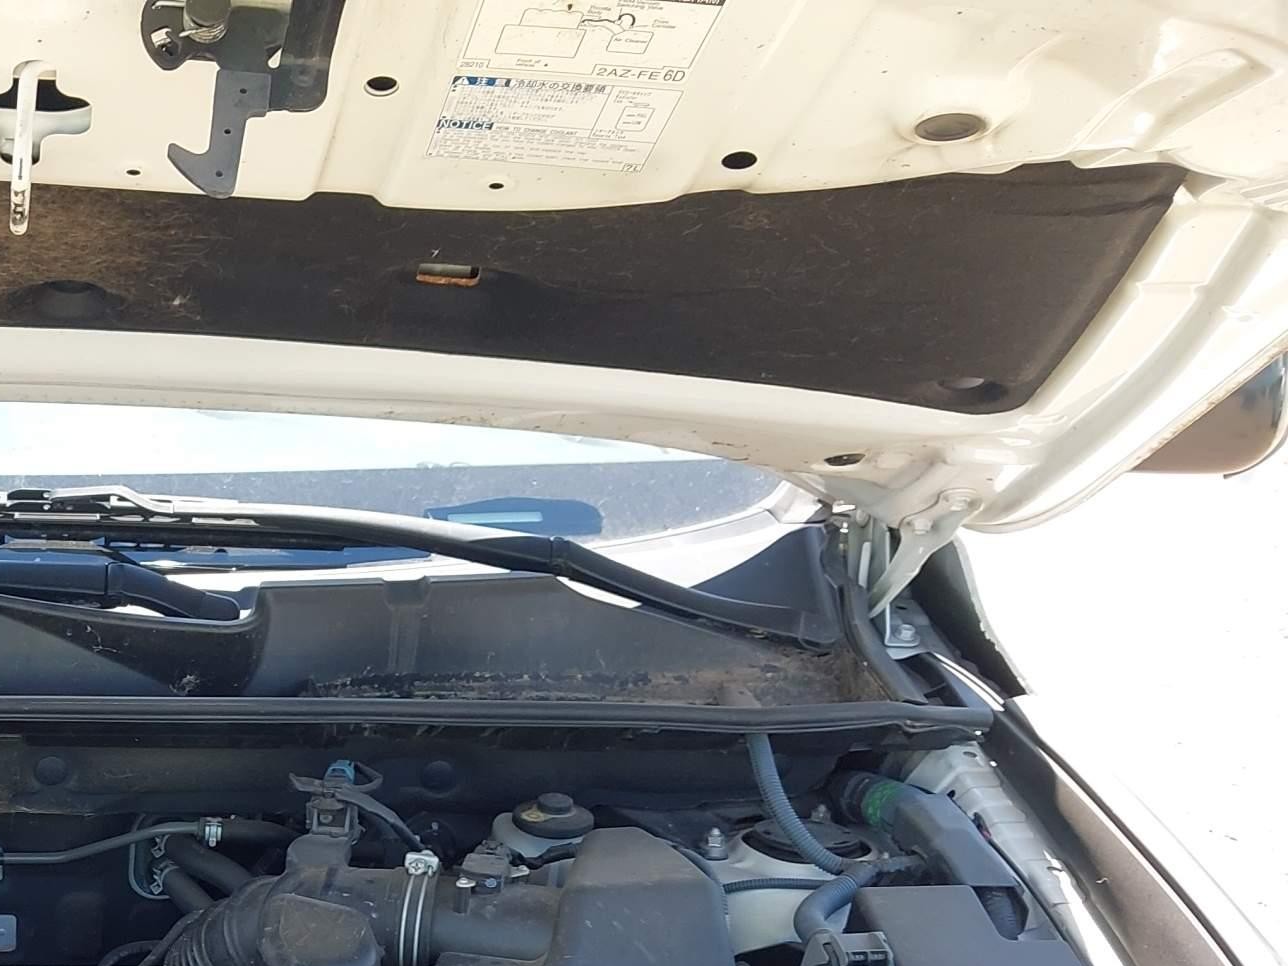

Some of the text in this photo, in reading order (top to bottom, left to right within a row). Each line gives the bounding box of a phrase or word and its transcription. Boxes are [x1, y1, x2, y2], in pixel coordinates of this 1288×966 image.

[596, 67, 662, 81] 2AZ-FE
[663, 69, 686, 81] 6D
[438, 119, 492, 131] NOTICE
